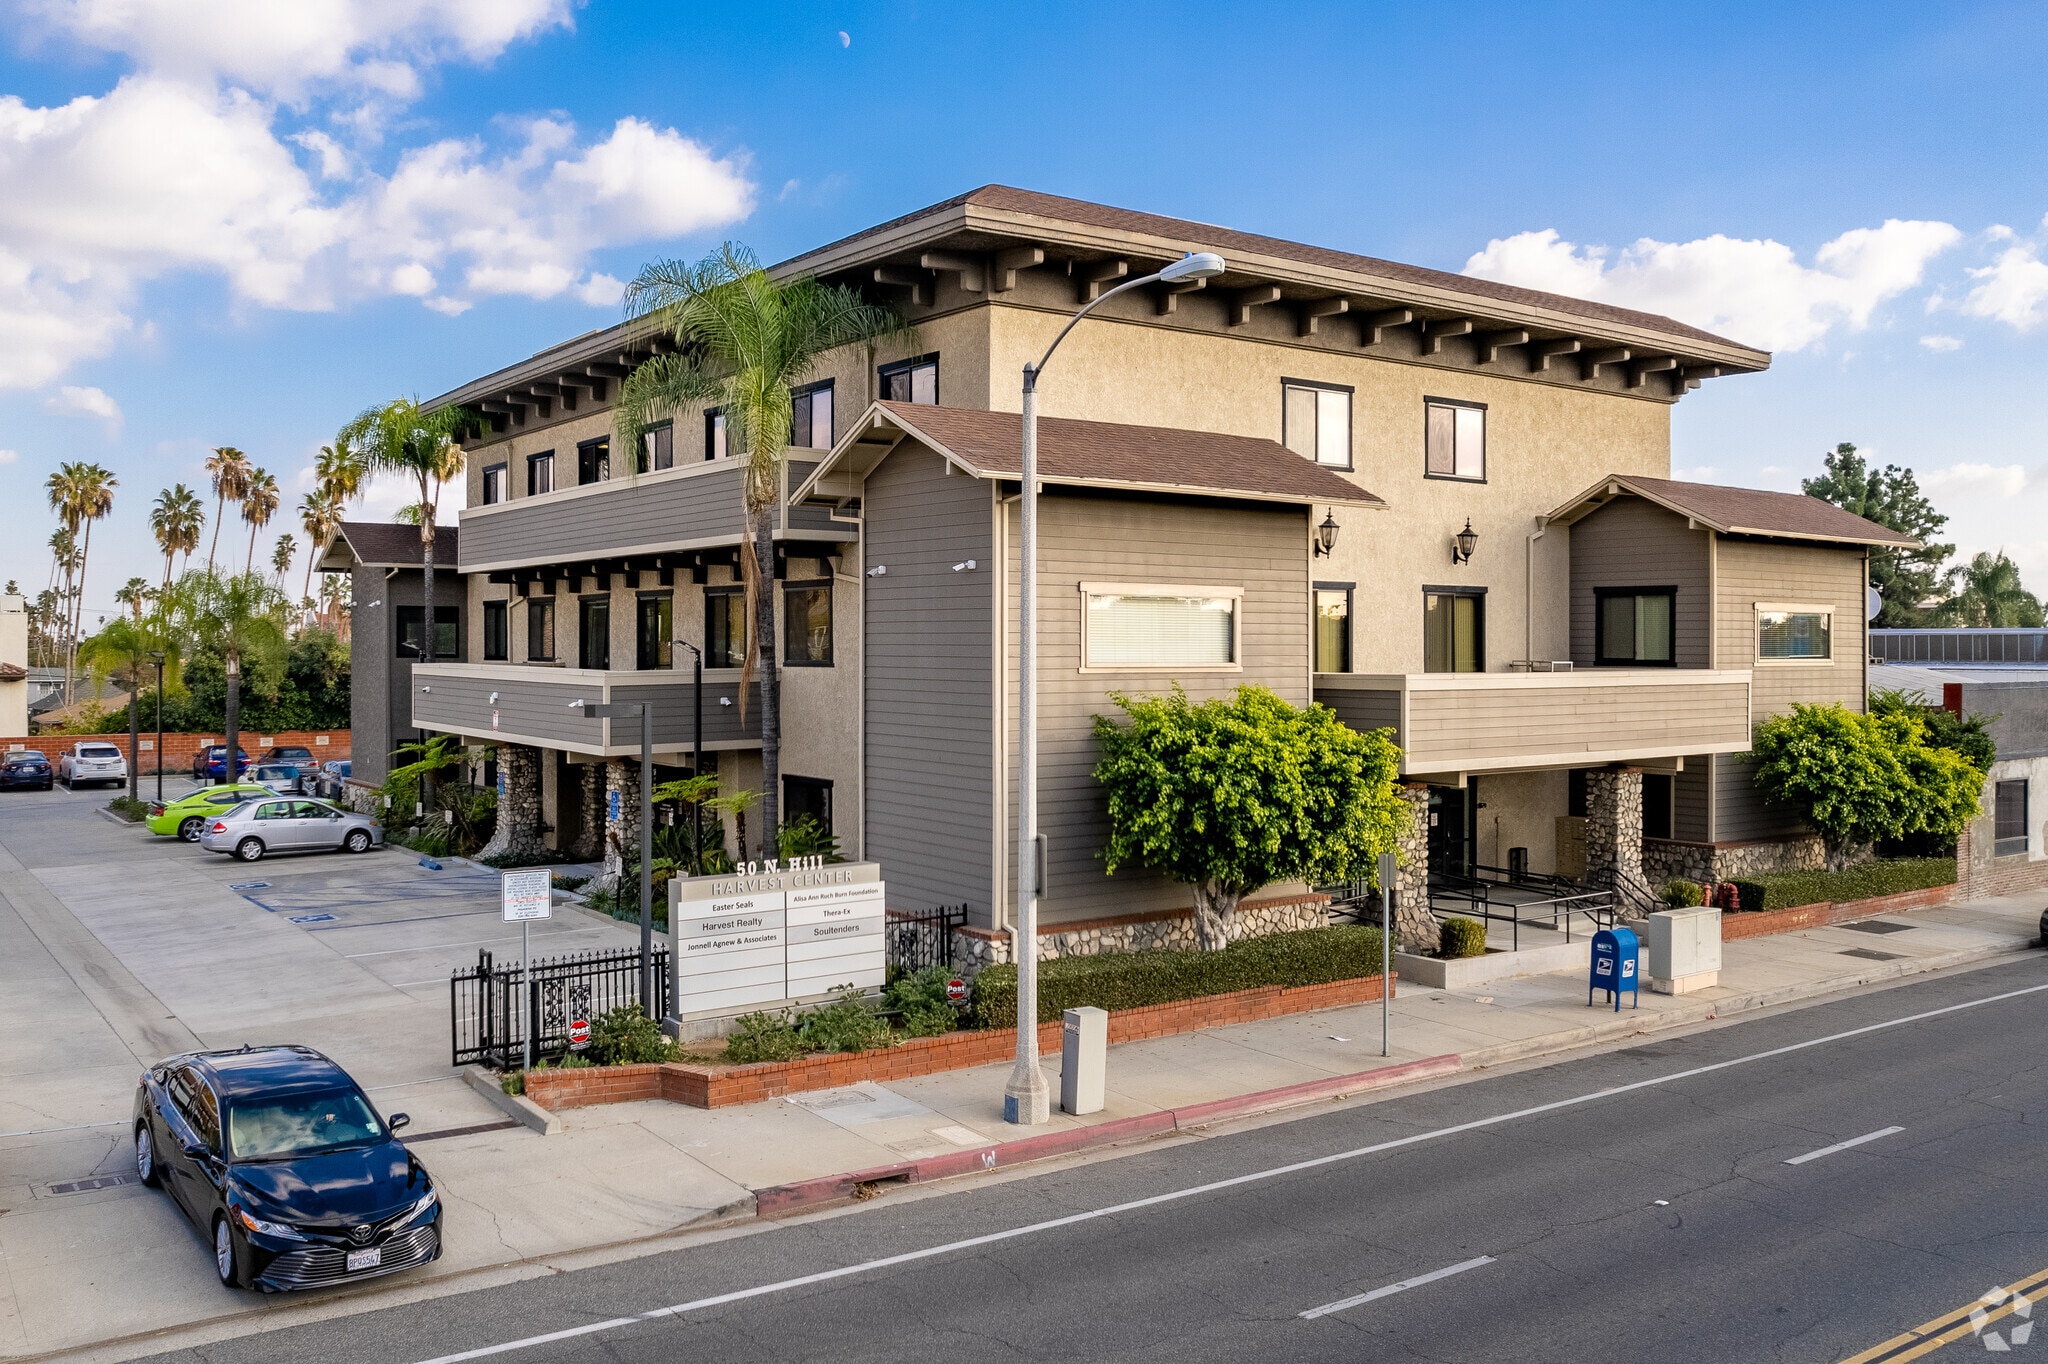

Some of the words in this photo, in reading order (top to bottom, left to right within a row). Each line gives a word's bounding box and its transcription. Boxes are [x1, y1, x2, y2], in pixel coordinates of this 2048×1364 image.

[736, 861, 757, 877] 50
[763, 859, 781, 874] N.
[788, 855, 824, 872] Hill
[711, 877, 785, 896] HARVEST
[792, 870, 853, 887] CENTER
[849, 888, 879, 897] Foundation
[712, 904, 734, 912] Easter
[735, 901, 754, 910] Seals
[823, 908, 851, 917] Thera-Ex
[702, 921, 735, 931] Harvest
[737, 918, 763, 928] Realty
[813, 925, 860, 936] Soultenders
[687, 941, 712, 951] Jonnell
[712, 939, 736, 949] Agnew
[744, 934, 777, 944] Associates
[570, 1025, 590, 1036] Post
